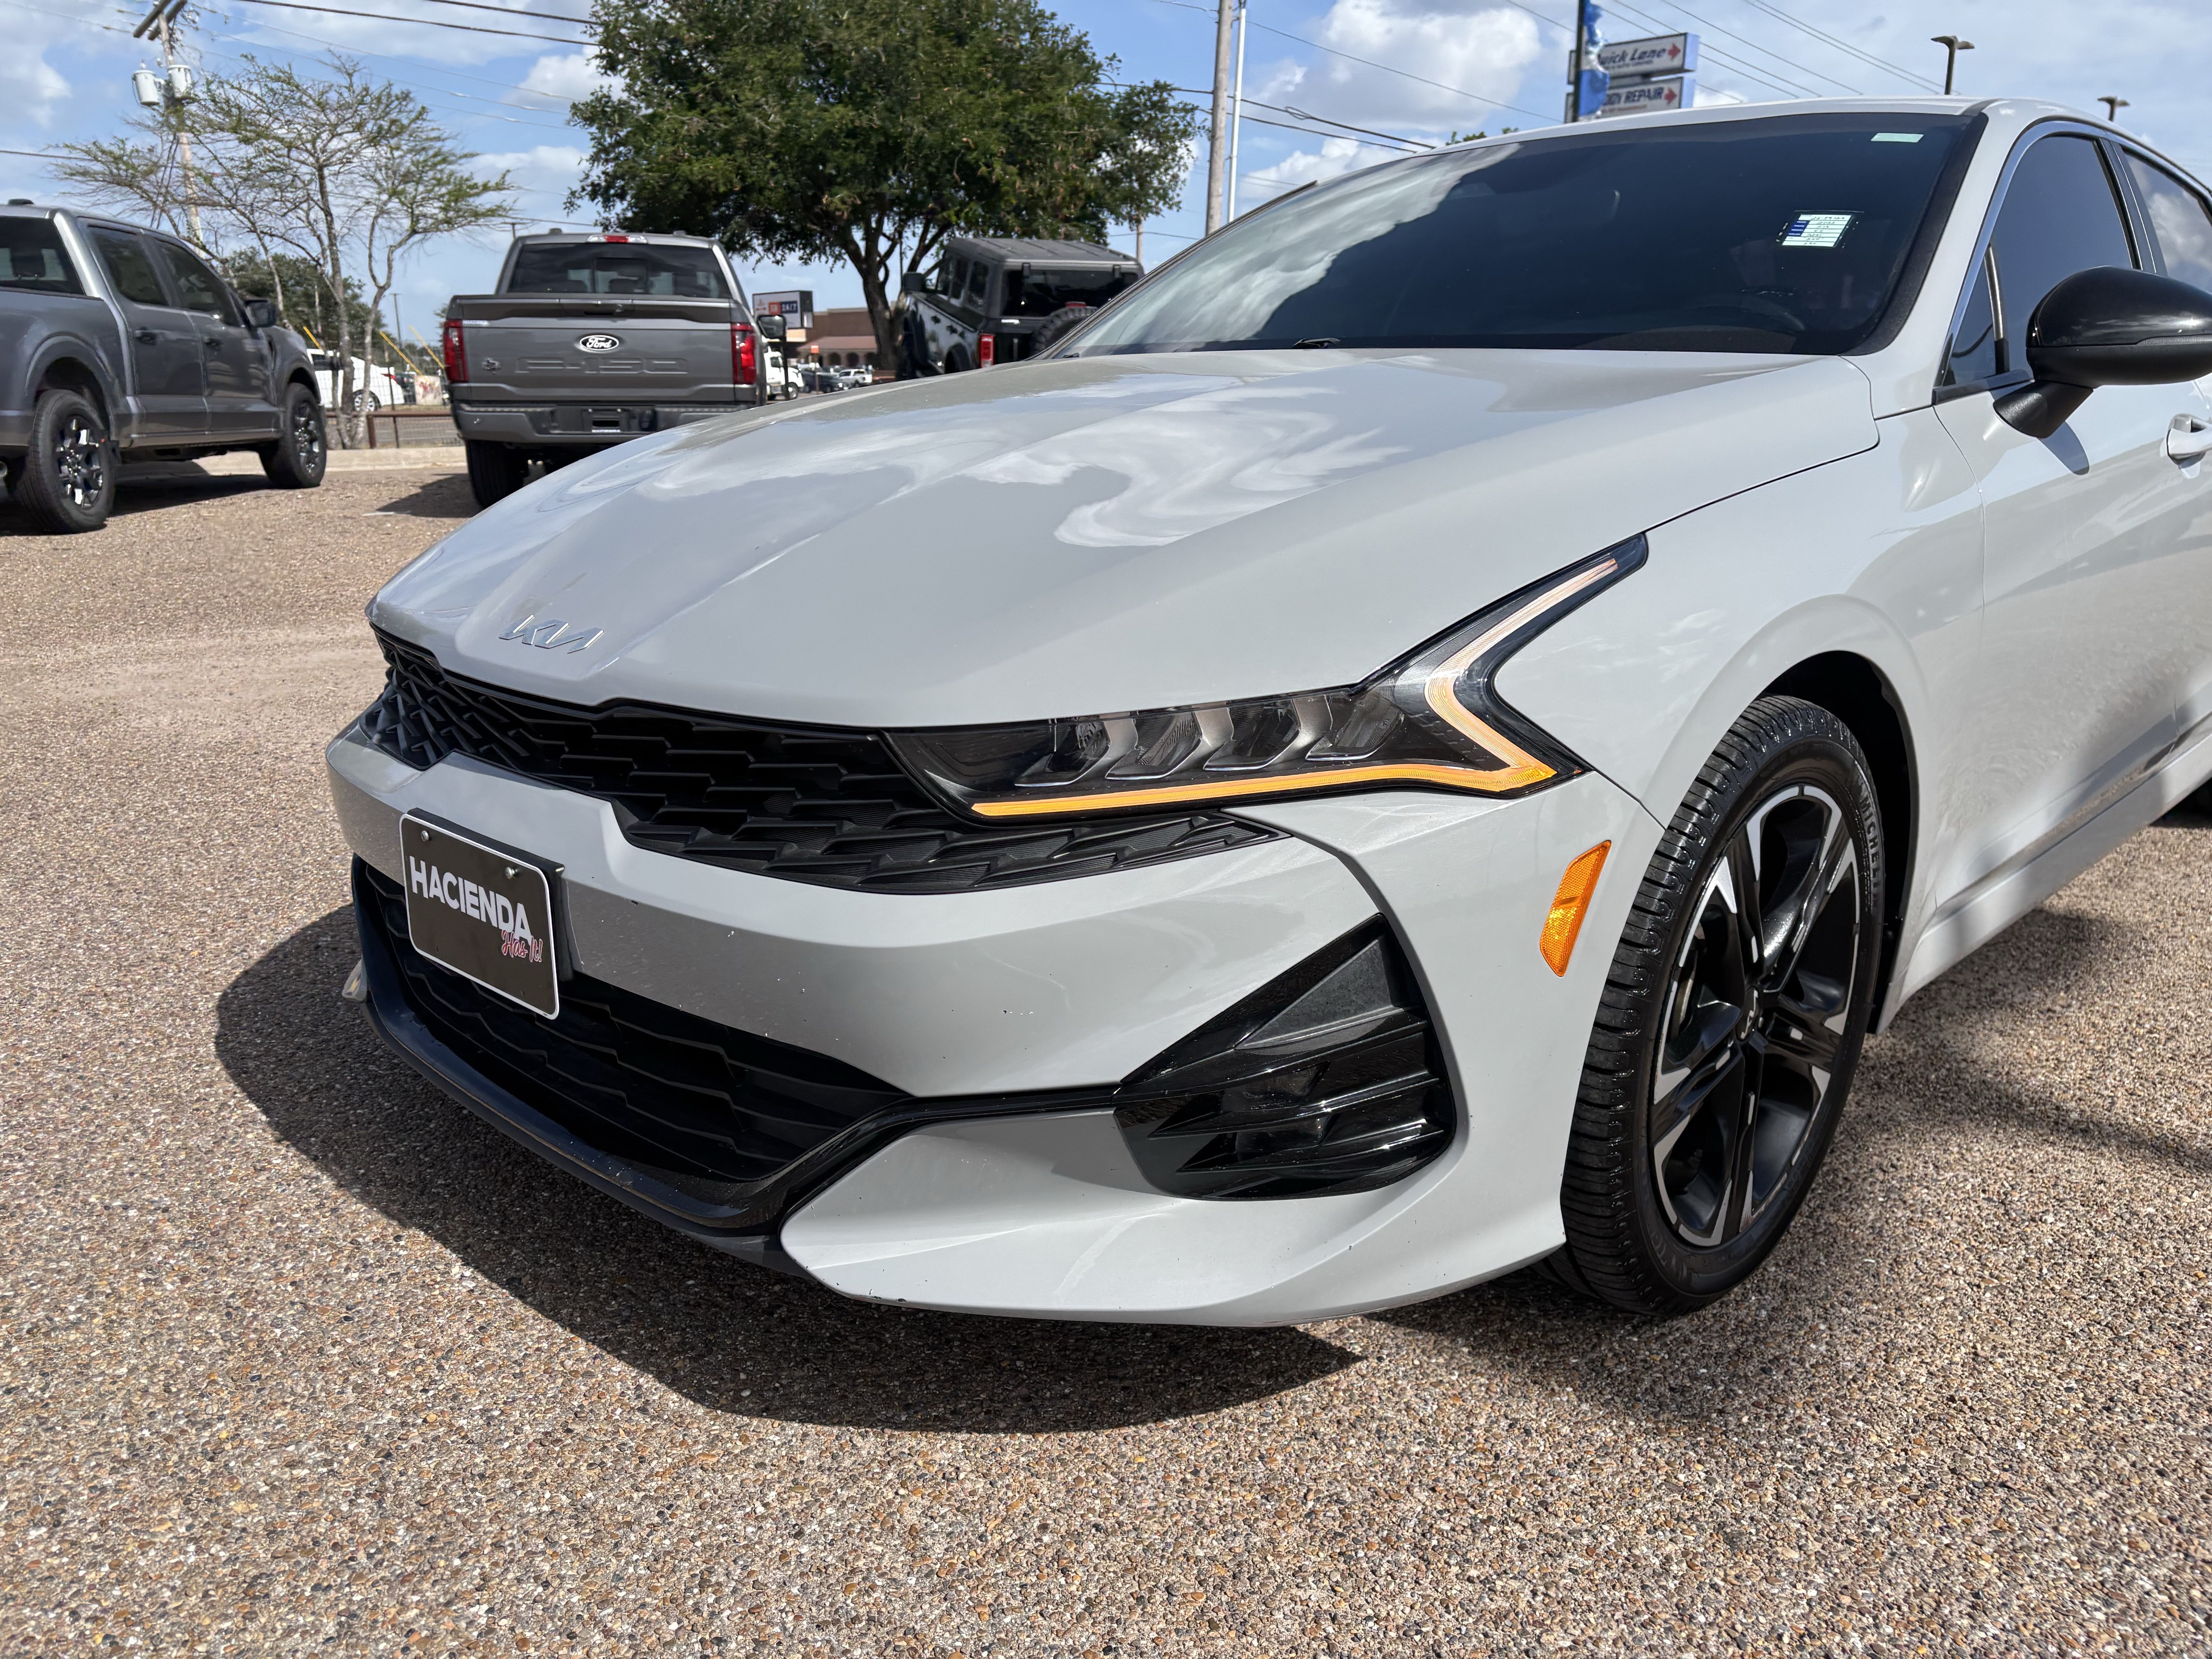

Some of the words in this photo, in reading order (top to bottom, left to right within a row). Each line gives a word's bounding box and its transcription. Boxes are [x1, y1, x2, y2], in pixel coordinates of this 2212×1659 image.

[1597, 49, 1628, 65] uick
[1630, 47, 1667, 61] Lane
[586, 337, 612, 348] Ford
[515, 357, 689, 374] F-150
[409, 855, 532, 946] HACIENDA
[501, 930, 528, 958] Has
[529, 935, 543, 963] It!
